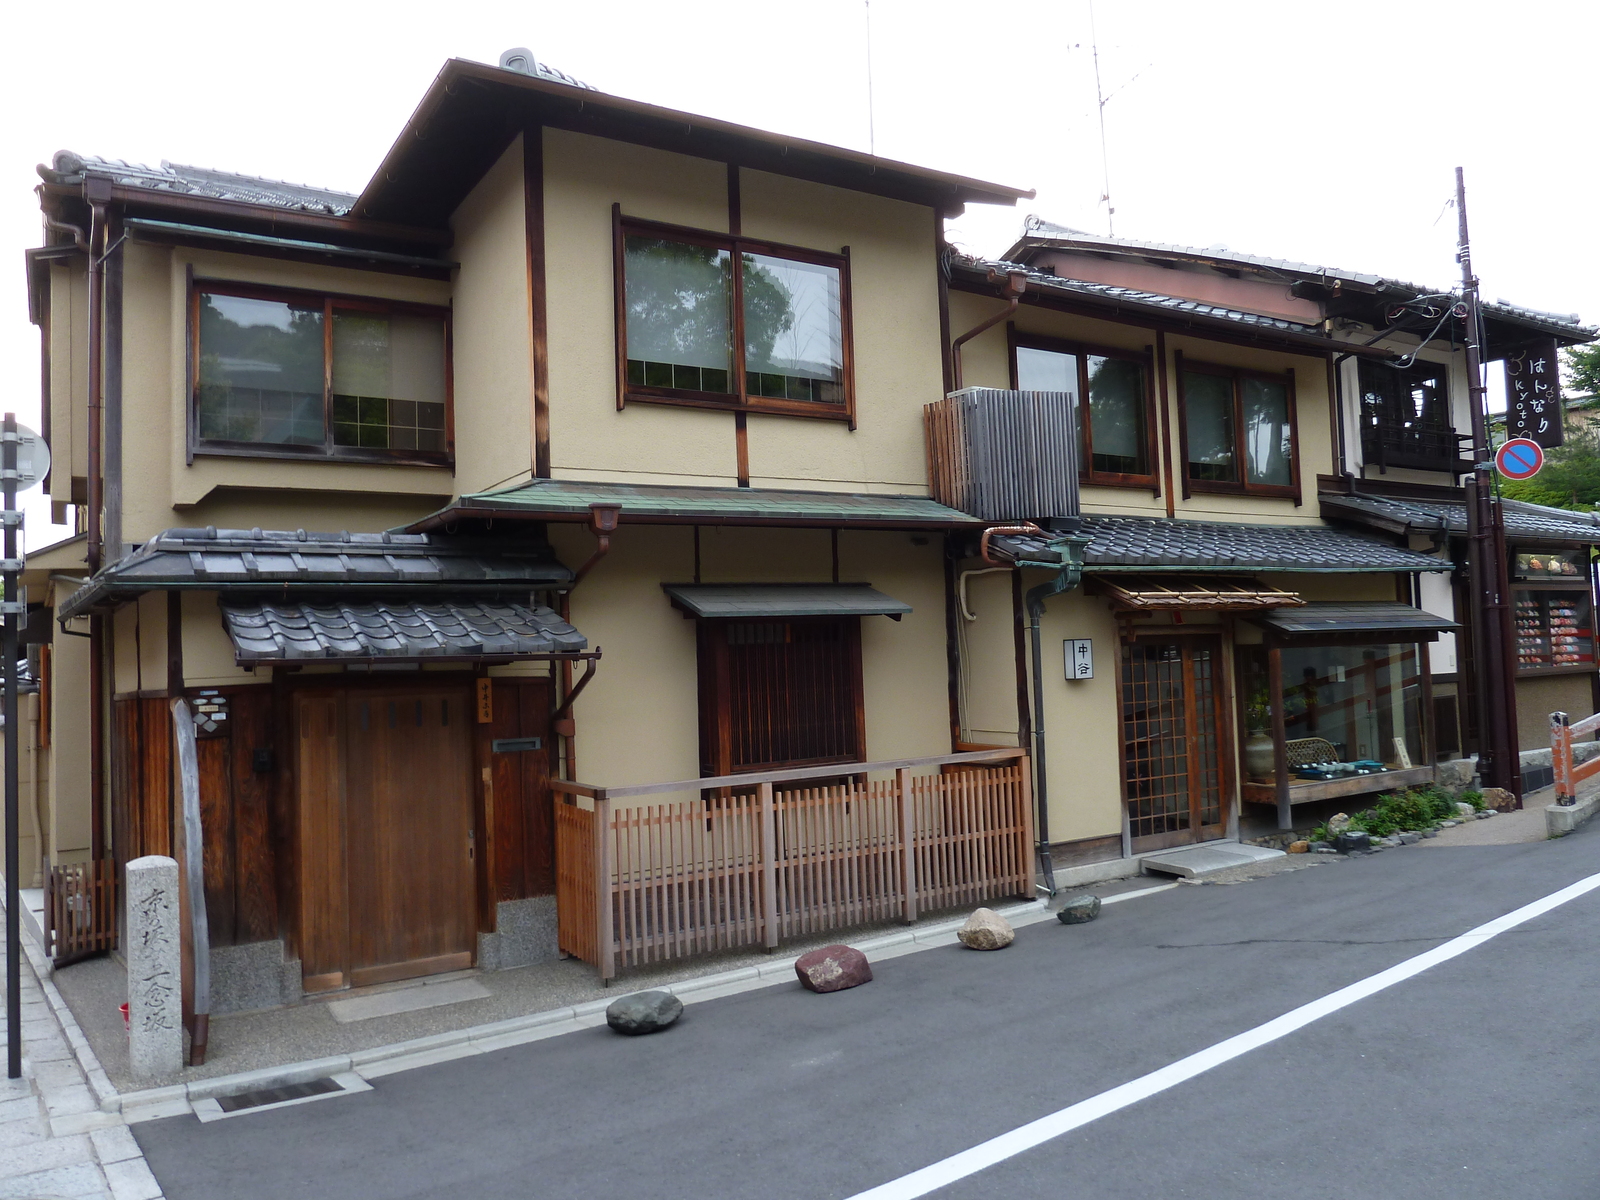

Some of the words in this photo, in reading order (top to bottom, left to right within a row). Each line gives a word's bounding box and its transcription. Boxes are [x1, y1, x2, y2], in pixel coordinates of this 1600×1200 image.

[1529, 357, 1548, 433] はんなり
[1077, 643, 1090, 675] 中谷
